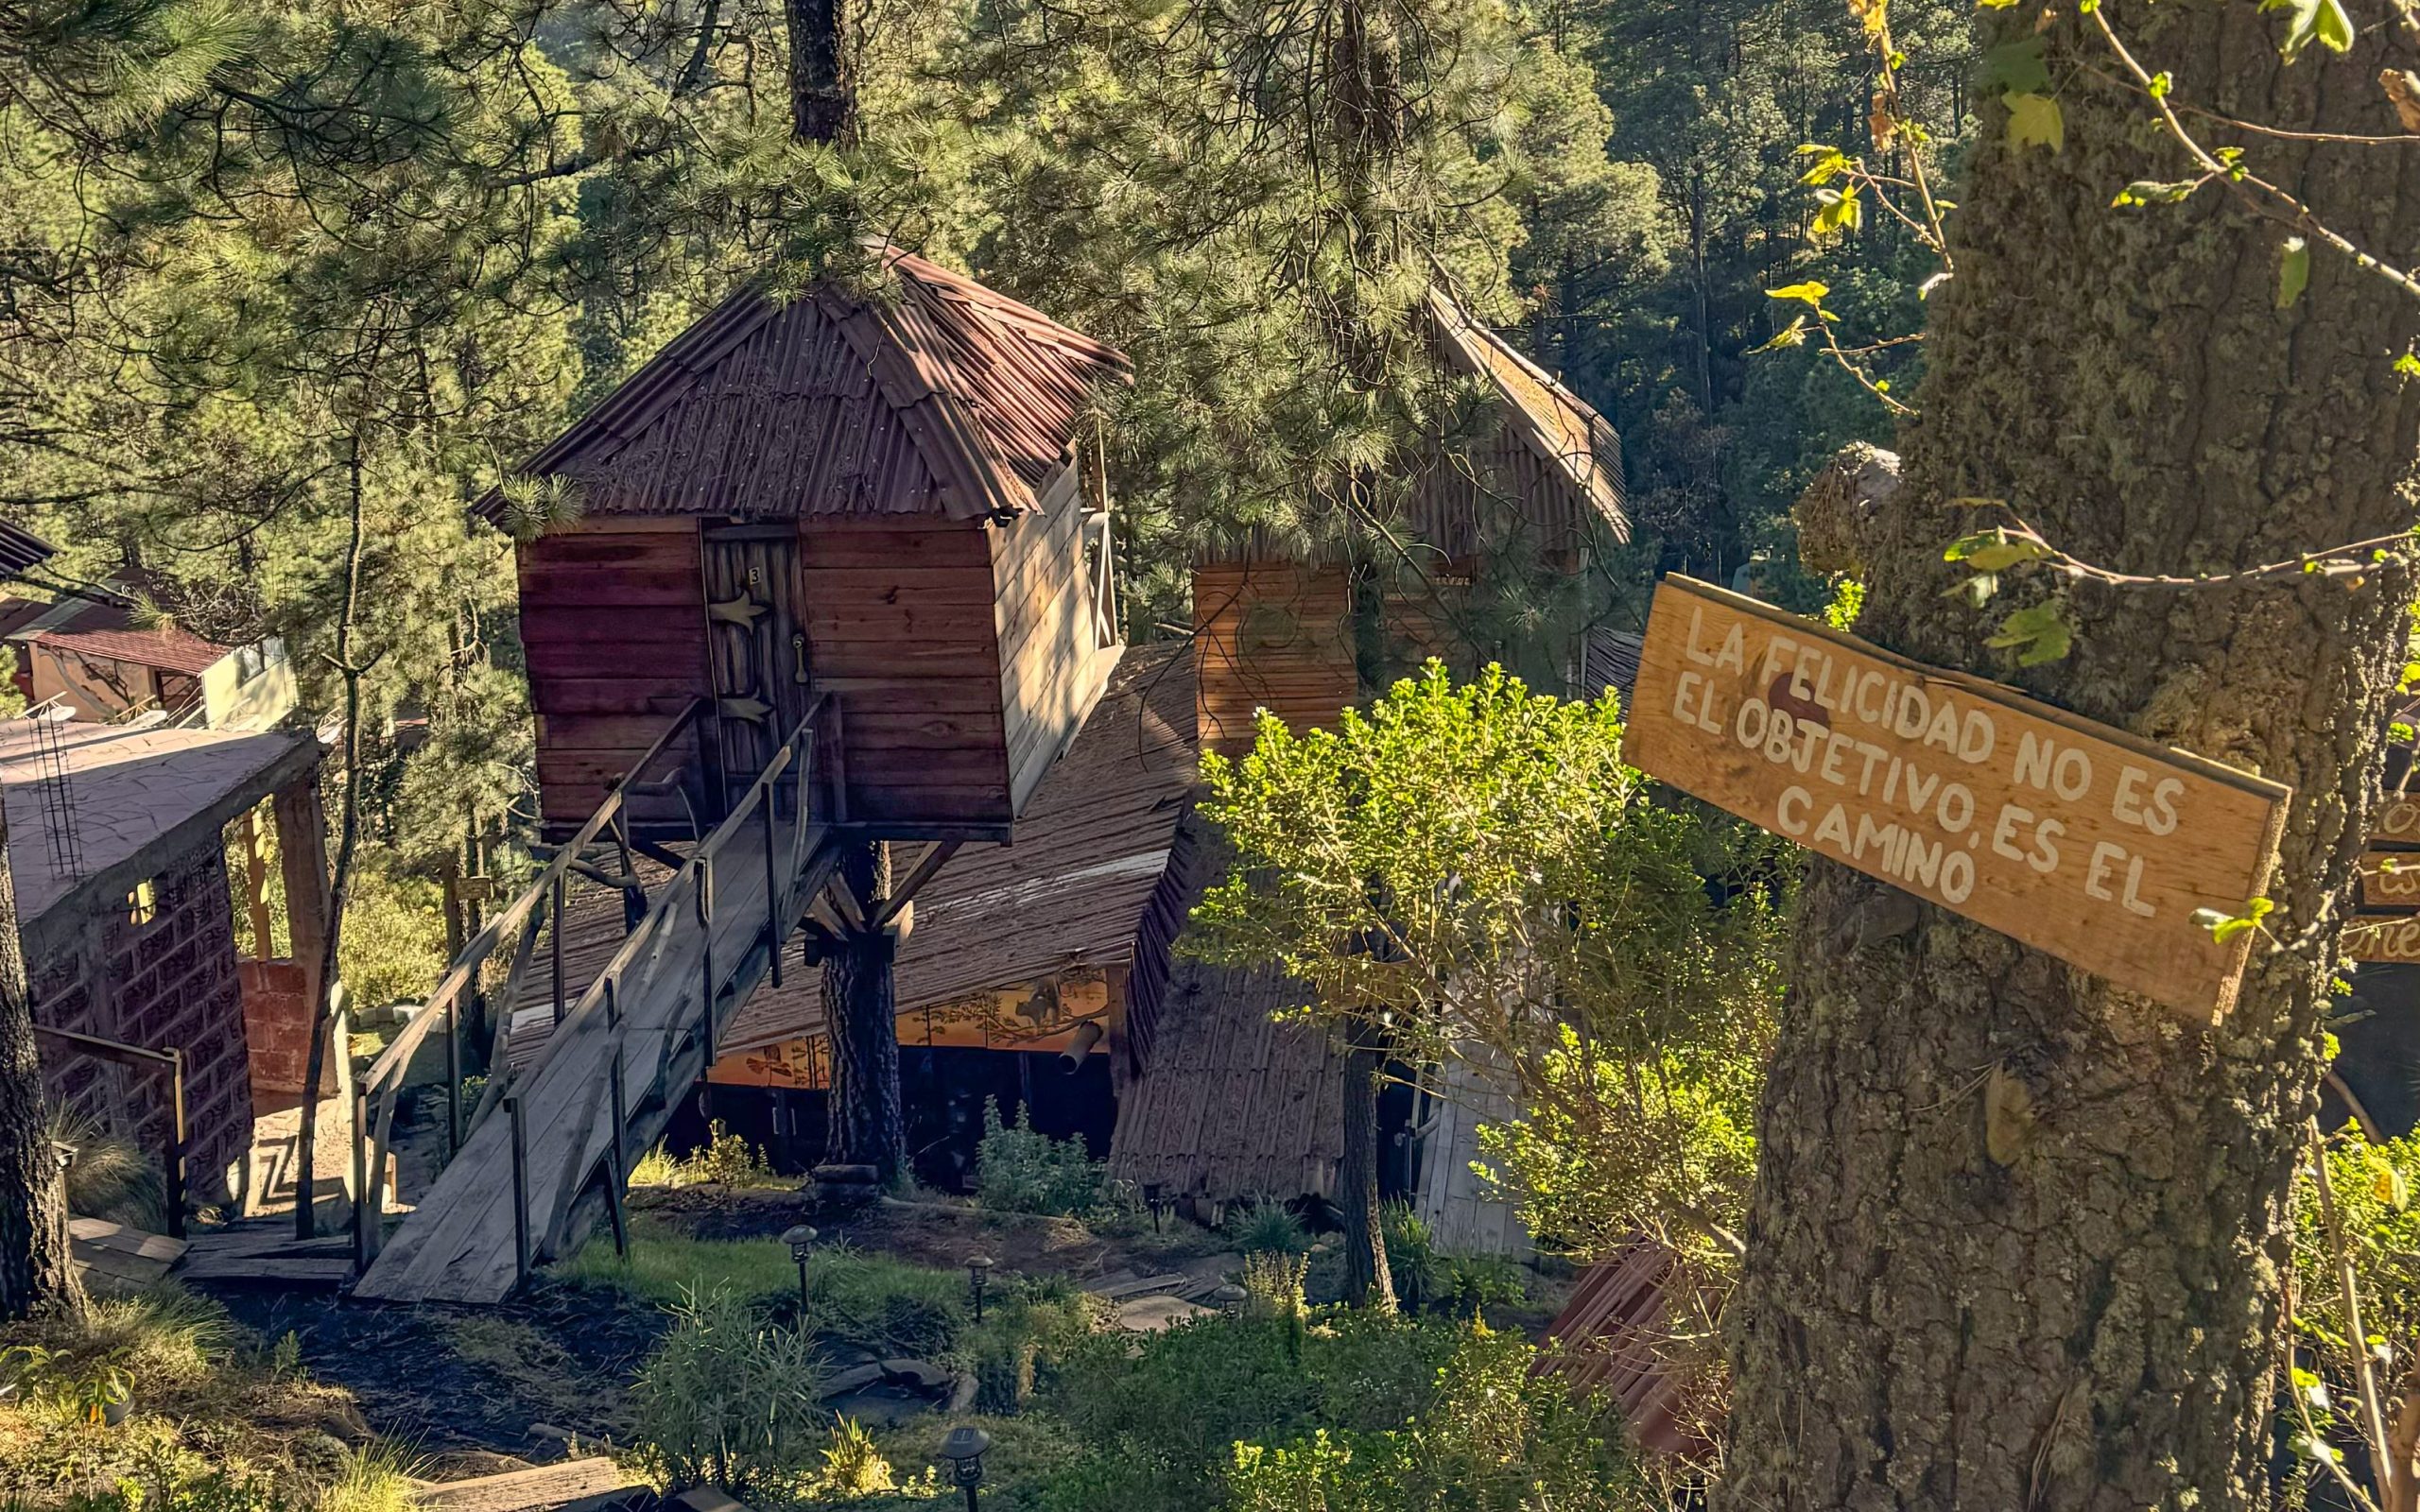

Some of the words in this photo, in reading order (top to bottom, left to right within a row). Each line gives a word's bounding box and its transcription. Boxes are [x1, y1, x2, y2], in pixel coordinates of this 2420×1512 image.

[1674, 674, 1721, 734] EL
[1737, 697, 1979, 849] OBJETIVO,
[1993, 806, 2066, 872] ES
[2085, 842, 2155, 917] EL
[1685, 607, 1744, 675] LA
[1762, 637, 1994, 764] FELICIDAD
[2014, 733, 2092, 800] NO
[2113, 766, 2185, 835] ES
[1778, 786, 1975, 902] CAMINO
